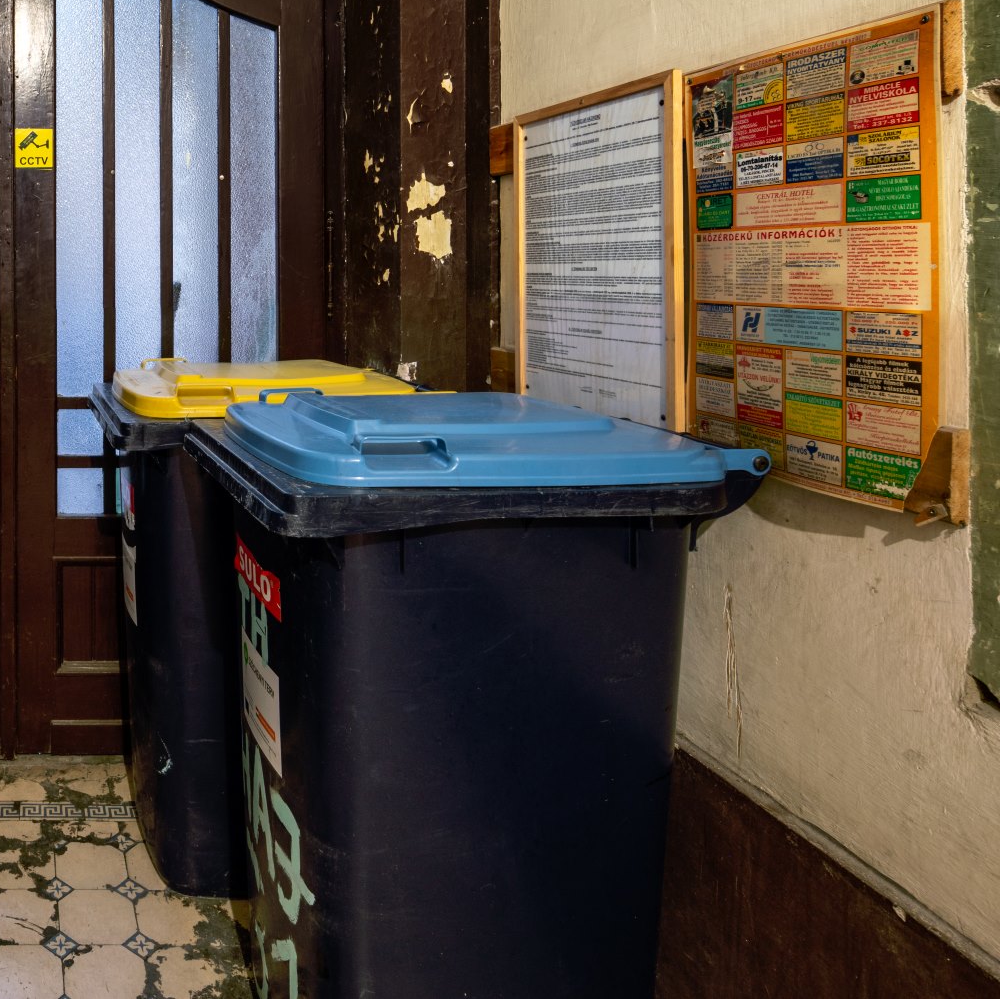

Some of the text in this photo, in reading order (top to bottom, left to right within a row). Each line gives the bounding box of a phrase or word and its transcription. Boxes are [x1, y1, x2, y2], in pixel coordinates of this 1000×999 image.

[787, 48, 845, 68] IRODASZER
[787, 56, 845, 75] NYOMTATVÁNY
[850, 86, 917, 104] NYELVISKOLA
[864, 82, 901, 94] MIRACLE
[20, 157, 48, 165] CCTV
[737, 155, 783, 167] Lomtalanítás
[757, 189, 815, 200] CENTRÁL HOTEL
[703, 231, 753, 243] KÖZÉRDEKŰ
[757, 228, 835, 241] INFORMÁCIÓK
[848, 369, 920, 382] KIRÁLY VIDEOTÉKA
[817, 451, 840, 463] PATIKA
[847, 448, 919, 469] Autószerelés
[239, 545, 271, 602] SULO
